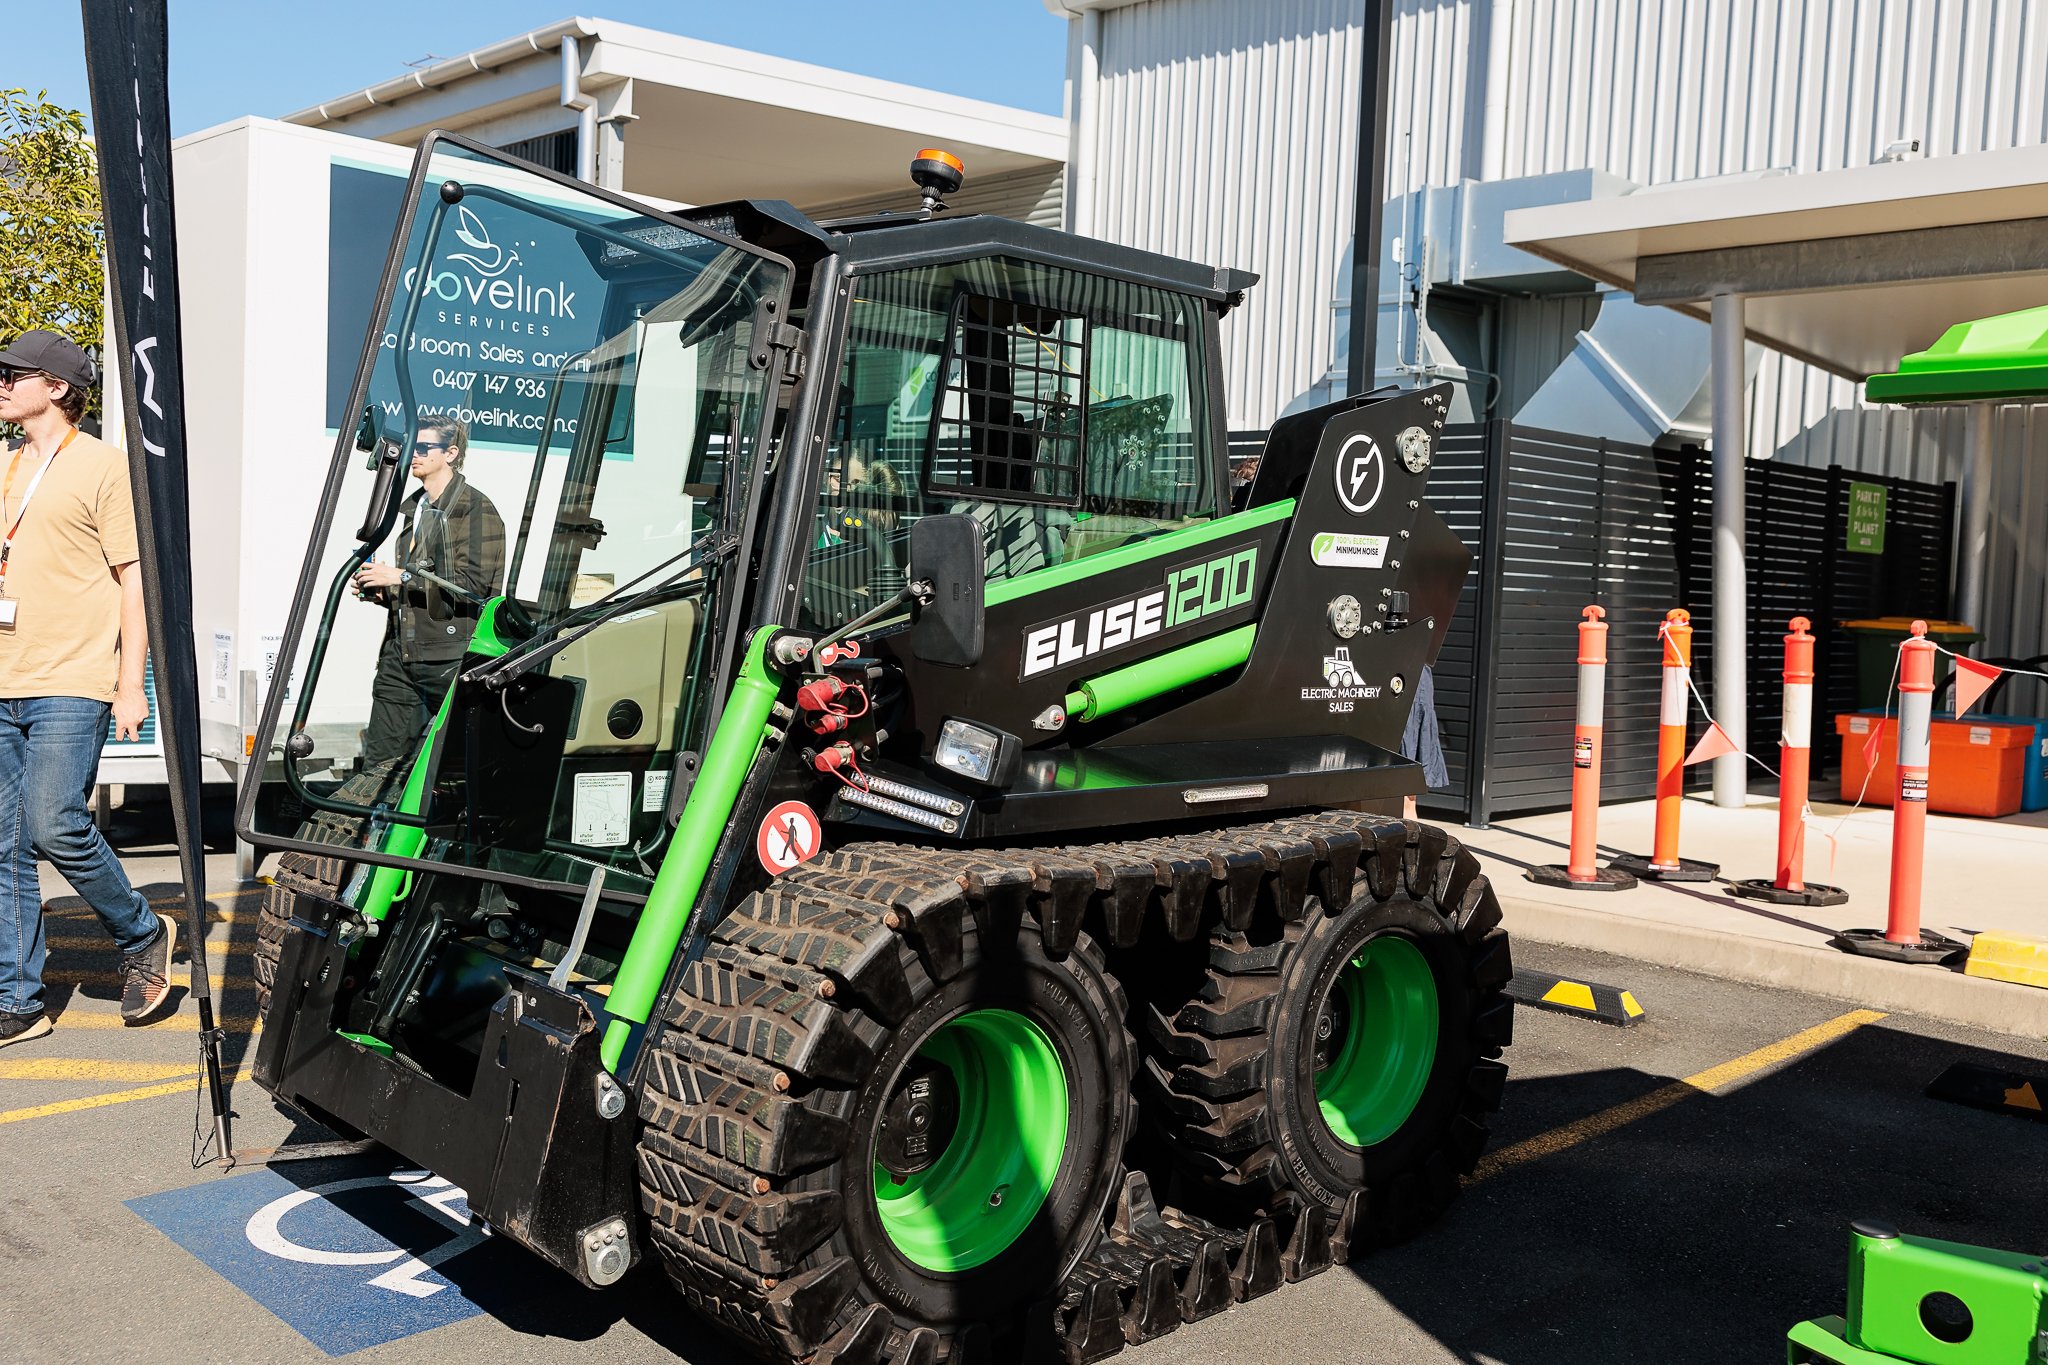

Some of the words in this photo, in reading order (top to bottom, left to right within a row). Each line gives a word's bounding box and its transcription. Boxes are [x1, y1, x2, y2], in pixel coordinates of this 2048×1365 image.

[404, 262, 576, 320] dovelink
[438, 311, 550, 336] SERVICES
[421, 337, 471, 358] room
[479, 341, 525, 364] Sales
[432, 369, 477, 391] 0407
[483, 373, 510, 395] 147
[515, 378, 546, 399] 936
[1853, 521, 1879, 536] PLANET
[1336, 546, 1361, 555] MINIMUM
[1362, 547, 1379, 556] NOISE
[1353, 537, 1379, 546] ELECTRIC
[1024, 590, 1165, 677] ELISE
[1165, 547, 1258, 629] 1200
[1301, 688, 1337, 699] ELECTRIC
[1338, 687, 1381, 698] MACHINERY
[1329, 702, 1354, 712] SALES
